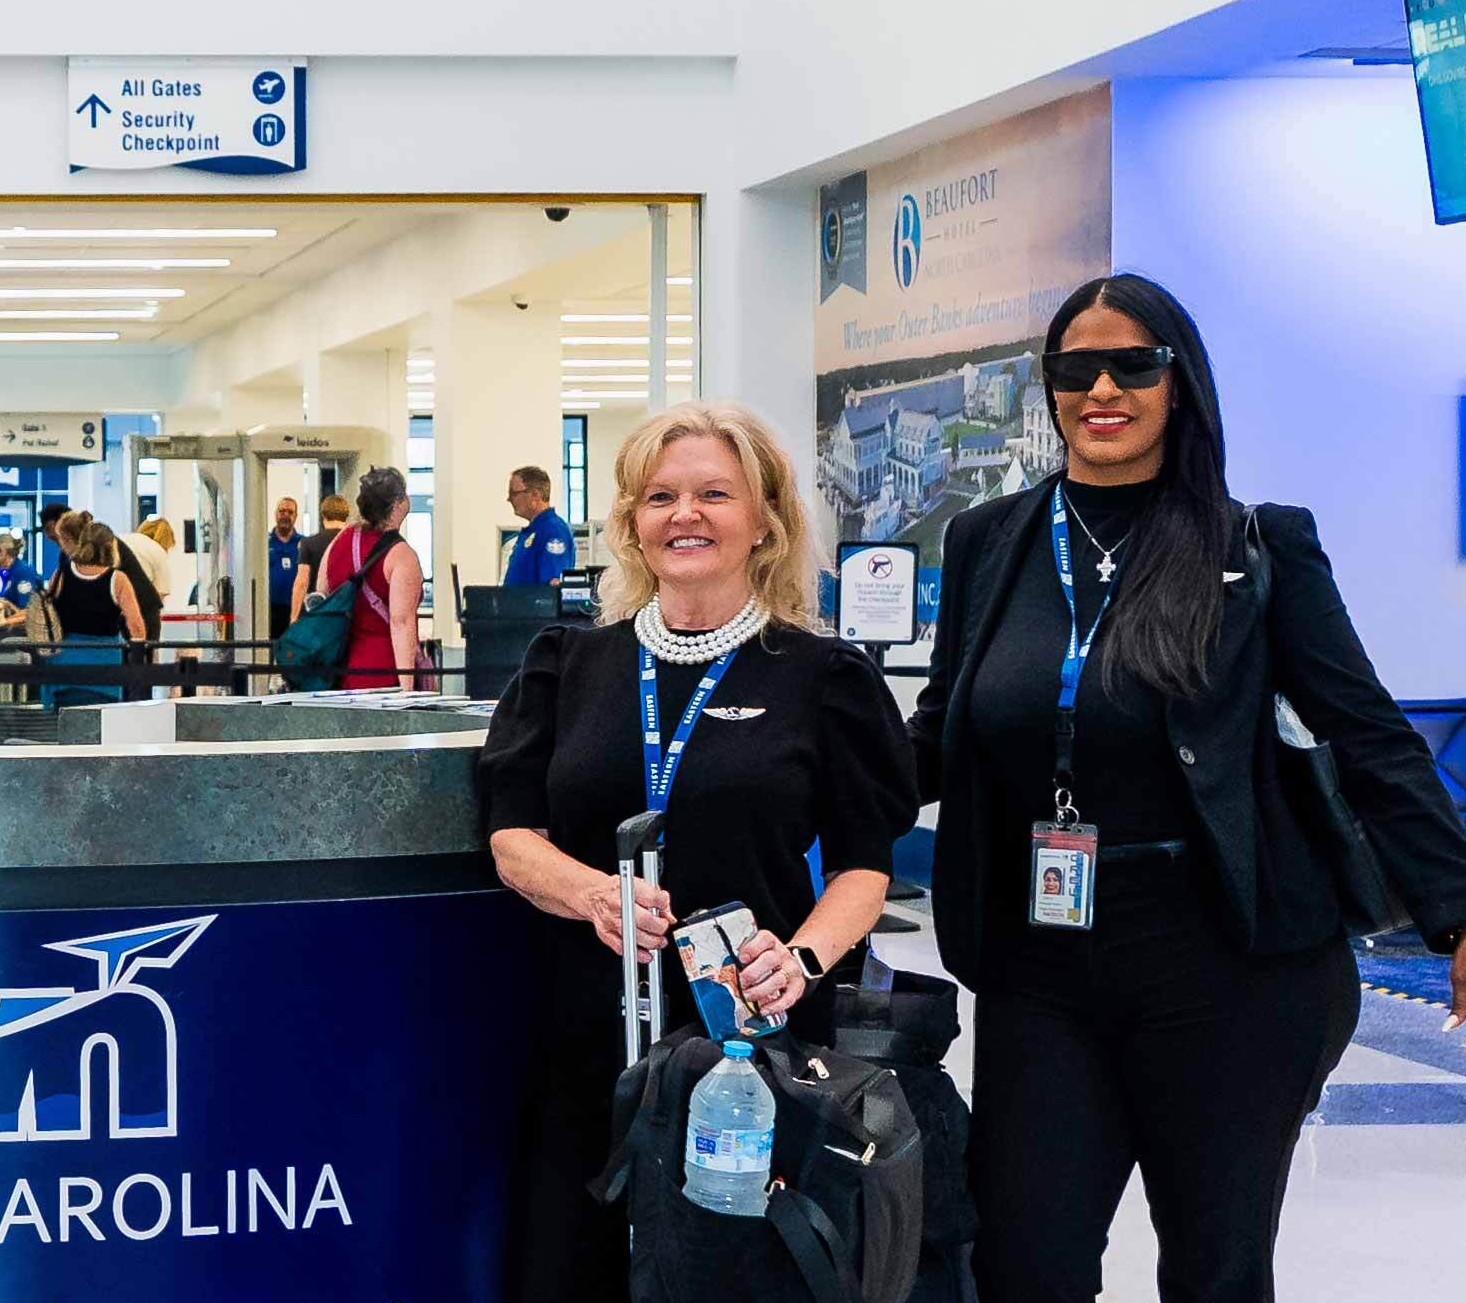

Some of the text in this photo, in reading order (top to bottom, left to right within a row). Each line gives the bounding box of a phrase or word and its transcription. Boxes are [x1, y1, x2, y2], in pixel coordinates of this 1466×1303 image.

[121, 79, 202, 97] All Gates
[122, 110, 195, 131] Security
[122, 133, 220, 154] Checkpoint
[925, 168, 999, 219] BEAUFORT
[942, 219, 977, 243] HOTEL
[843, 316, 871, 351] Where
[296, 437, 330, 448] leidos
[1058, 537, 1069, 571] EASTERN
[645, 694, 656, 729] EASTERN
[683, 691, 706, 725] EASTERN
[657, 756, 676, 795] EASTERN
